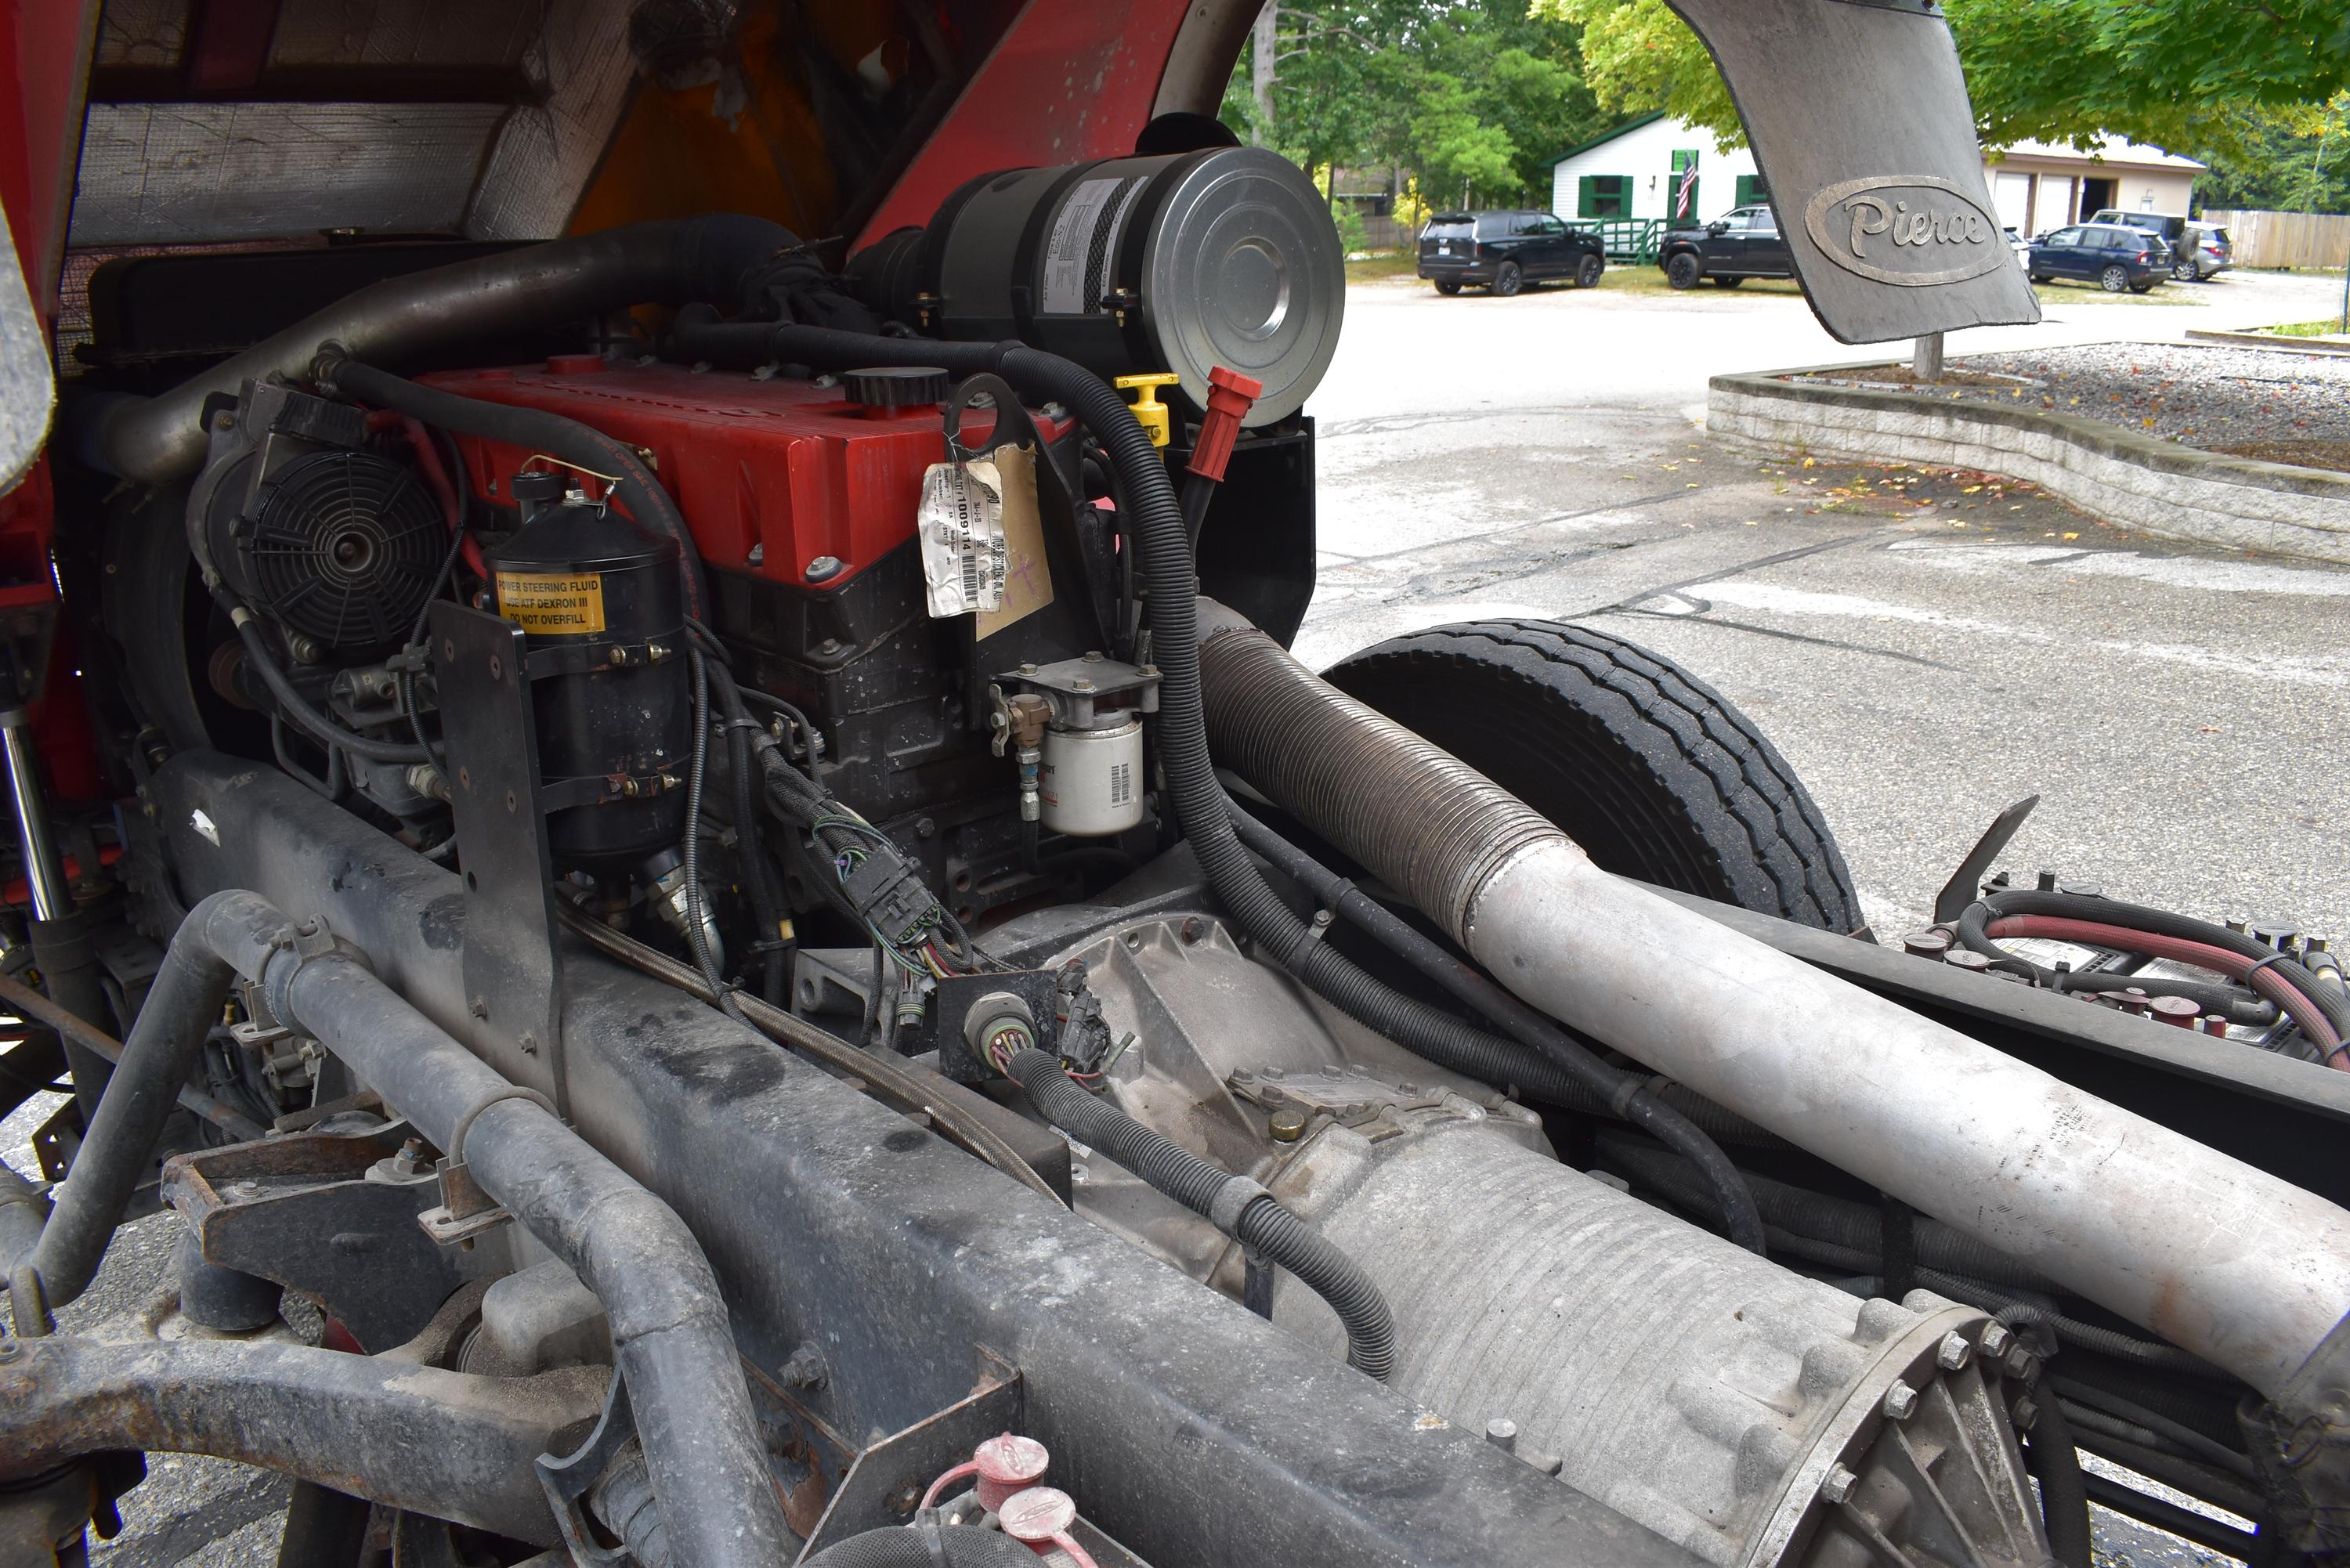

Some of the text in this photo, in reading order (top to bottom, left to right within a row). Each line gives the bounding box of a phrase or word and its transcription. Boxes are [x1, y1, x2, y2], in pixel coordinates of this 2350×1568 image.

[1844, 196, 1986, 258] Pierce
[957, 497, 971, 550] 1009114
[499, 580, 598, 592] POWER STEERING FLUID
[507, 598, 588, 609] USE ATF DEXRON III
[510, 613, 586, 625] DO NOT OVERFILL
